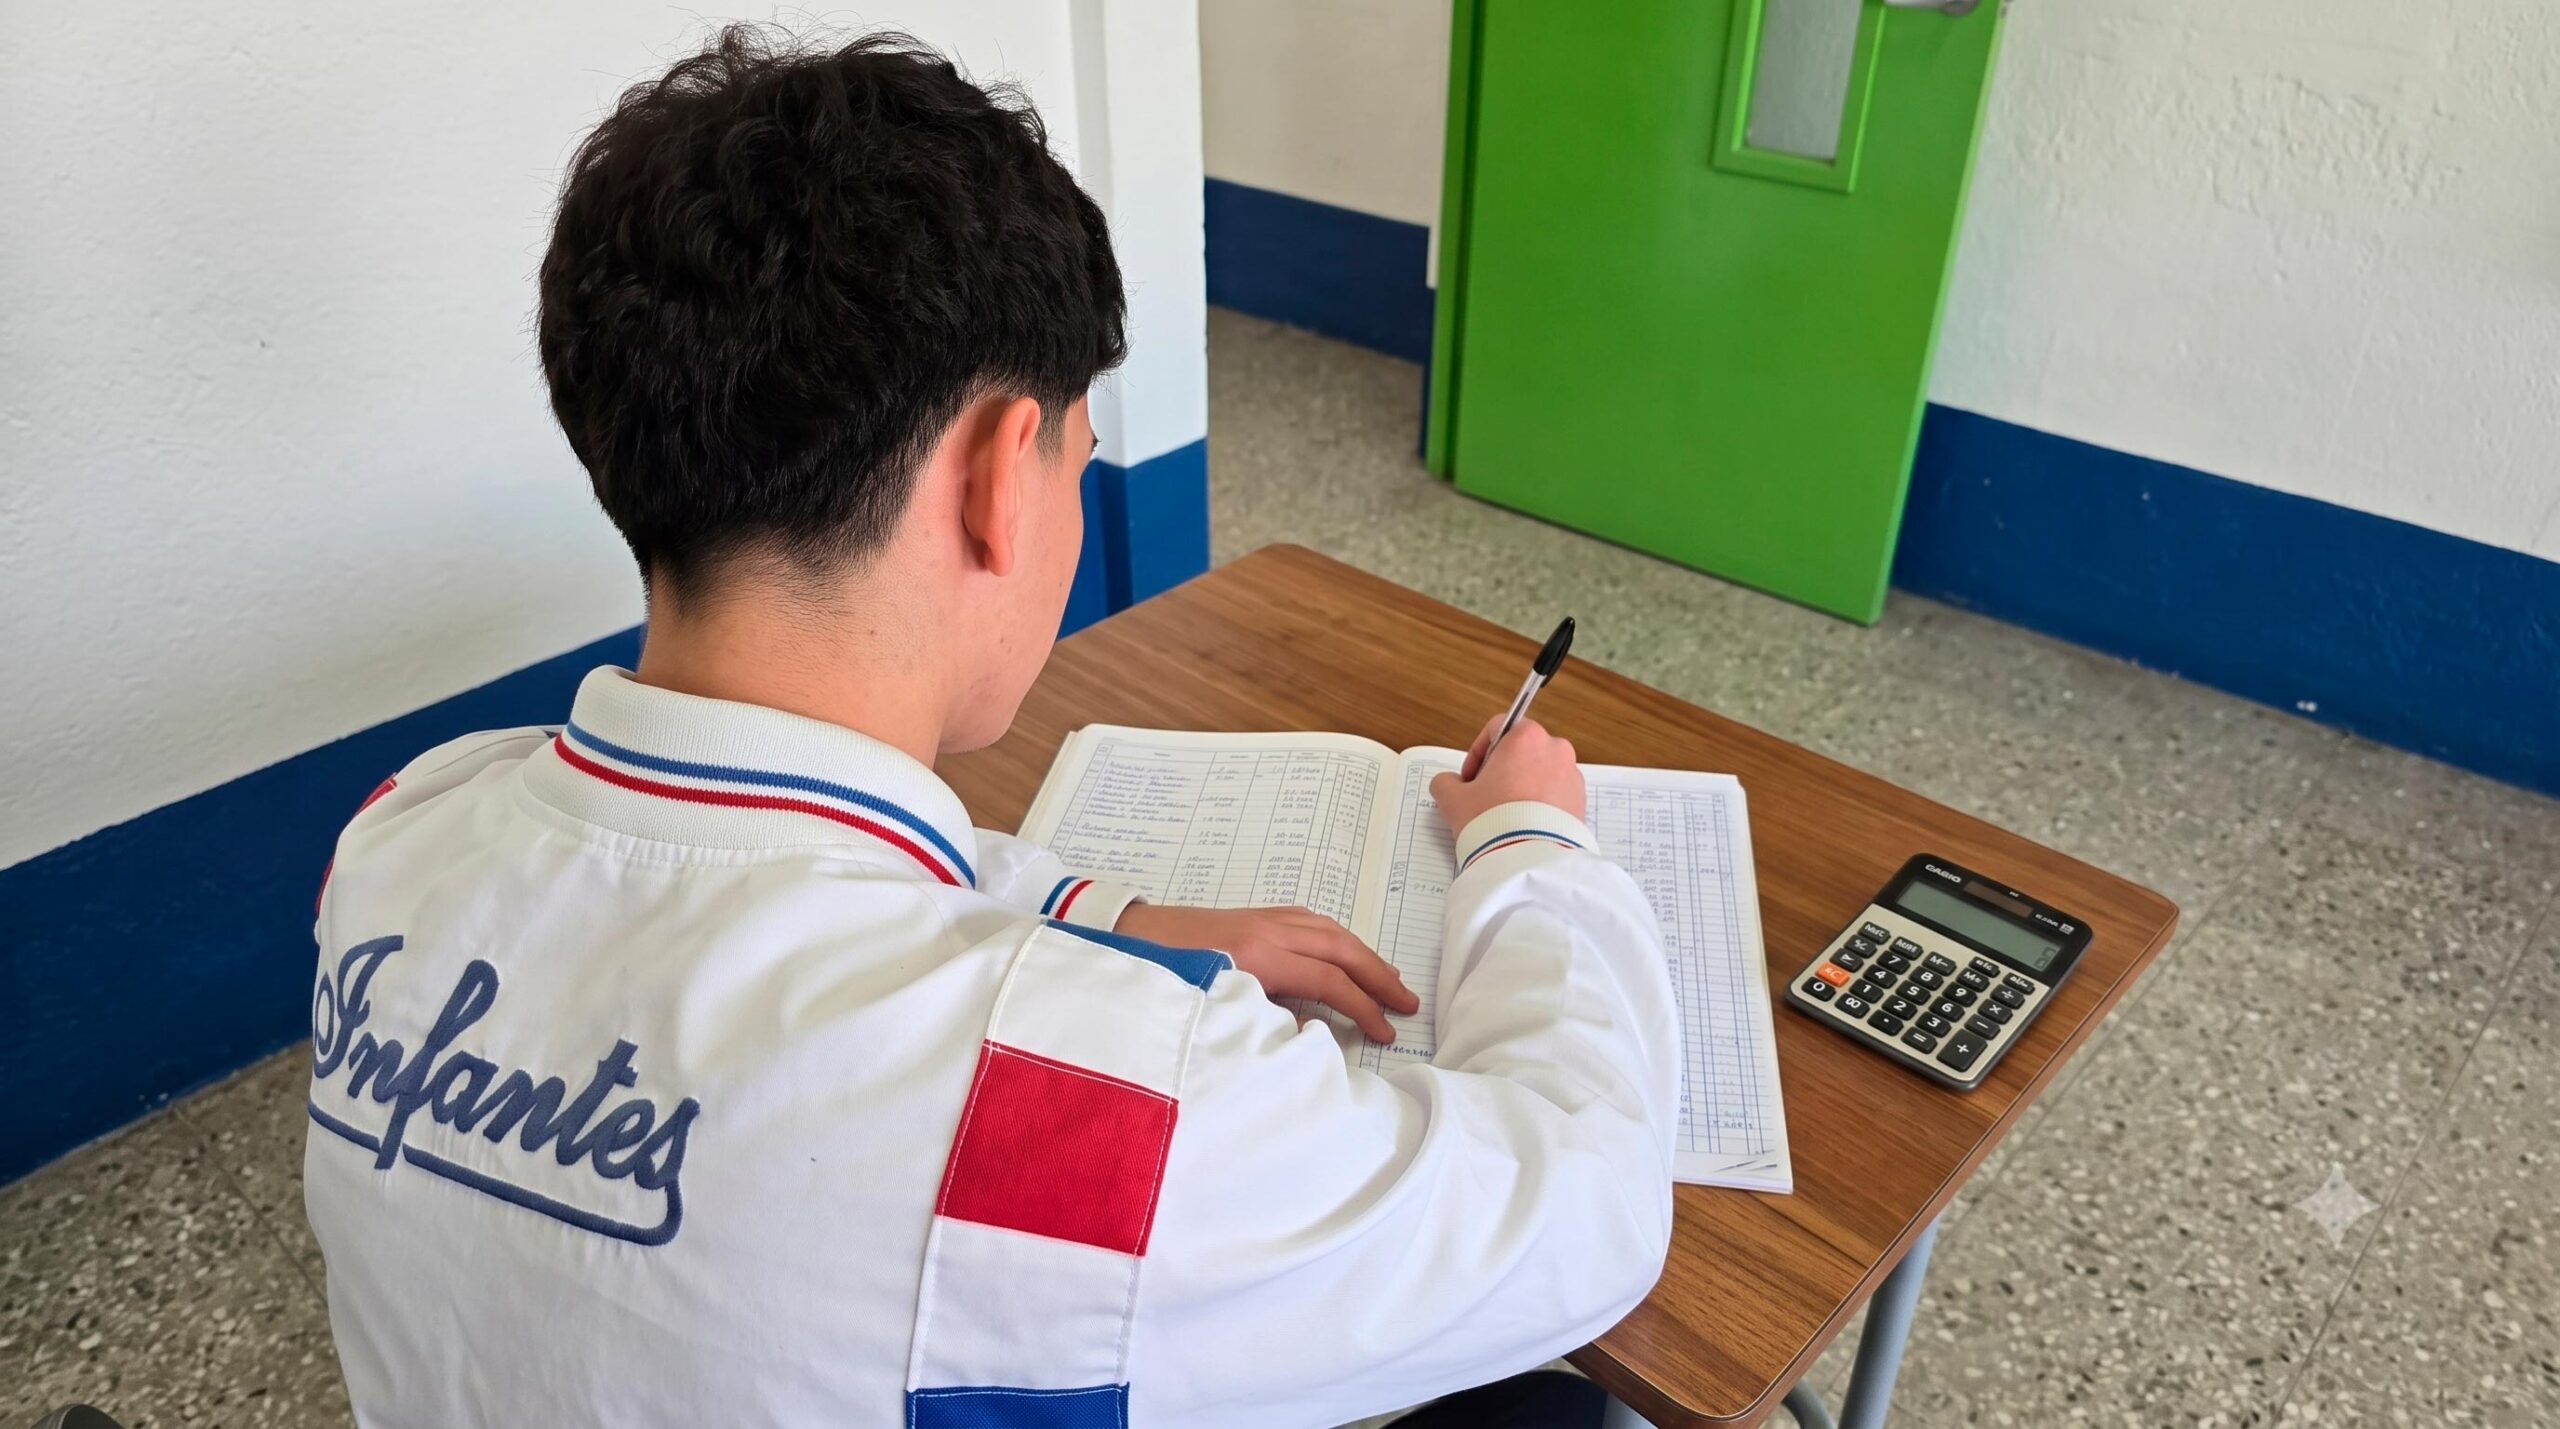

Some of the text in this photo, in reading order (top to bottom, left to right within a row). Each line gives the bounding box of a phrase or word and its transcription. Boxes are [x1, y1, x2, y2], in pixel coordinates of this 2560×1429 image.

[1888, 955, 1901, 965] 7
[1875, 970, 1887, 980] 4
[1920, 971, 1934, 982] 8
[1862, 984, 1872, 993] 1
[1907, 985, 1920, 996] 5
[1955, 988, 1967, 997] 9
[1893, 1000, 1907, 1011] 2
[1941, 1002, 1954, 1013] 6
[1927, 1017, 1941, 1028] 3
[313, 934, 700, 1190] Infantes
